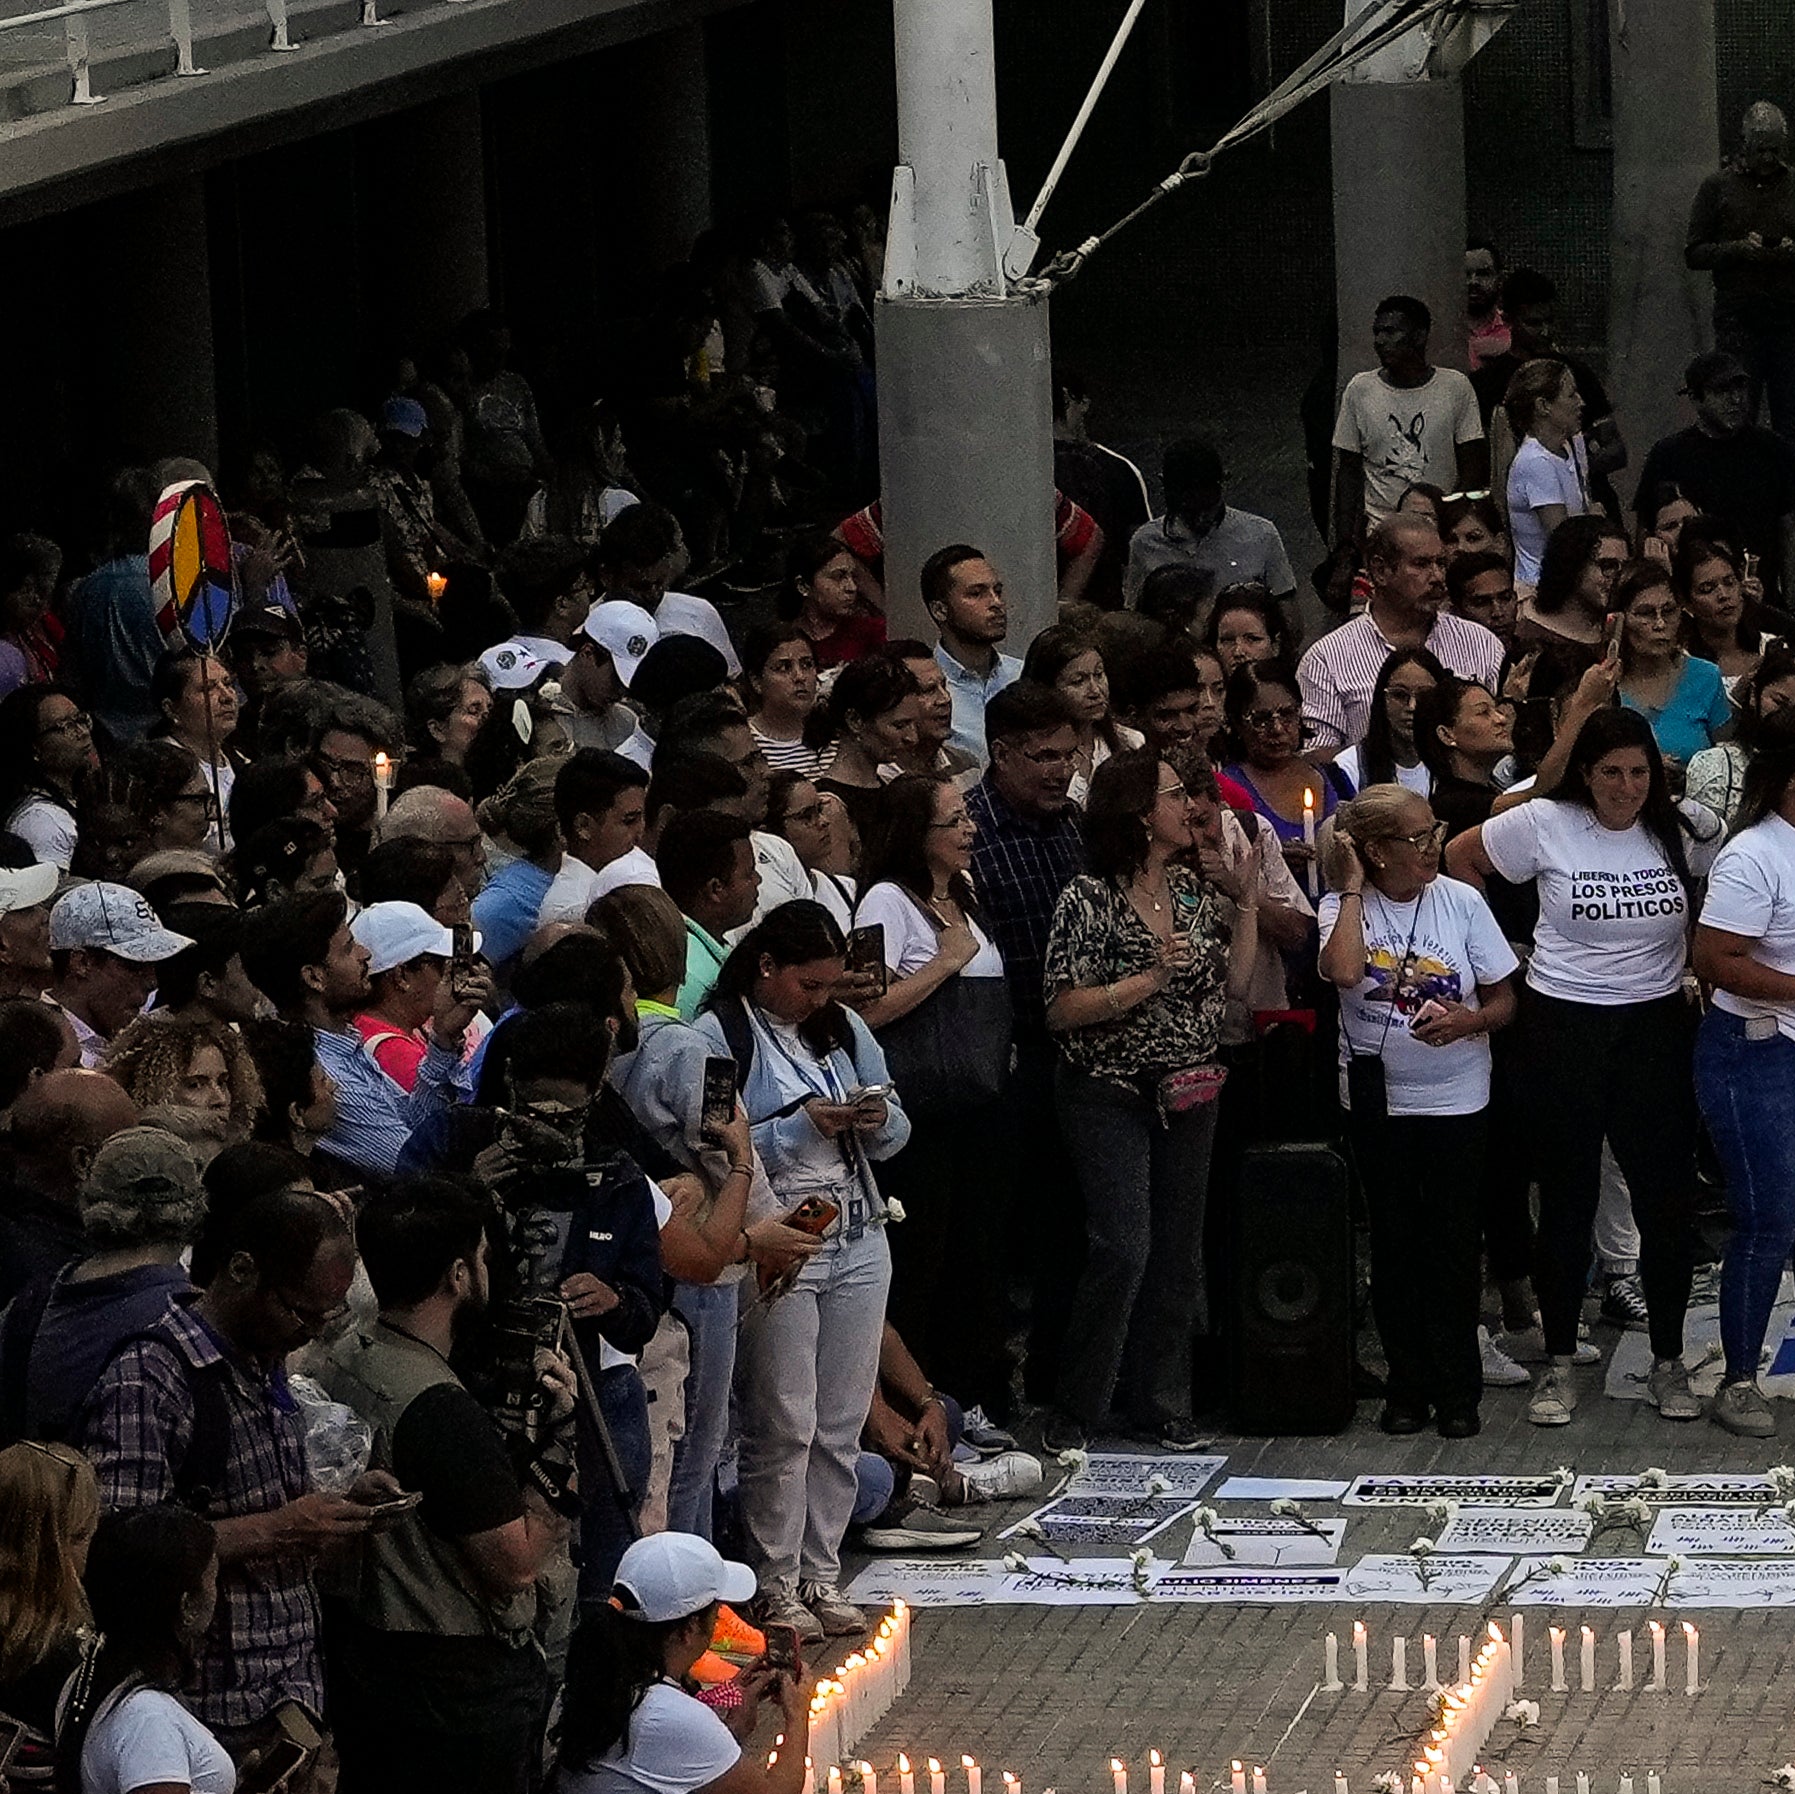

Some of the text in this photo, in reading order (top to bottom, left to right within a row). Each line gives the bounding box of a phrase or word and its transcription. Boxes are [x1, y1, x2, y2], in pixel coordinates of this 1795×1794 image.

[1572, 867, 1673, 882] LIBEREN A TODOS
[1572, 878, 1679, 899] LOS PRESOS
[1572, 895, 1684, 921] POLÍTICOS
